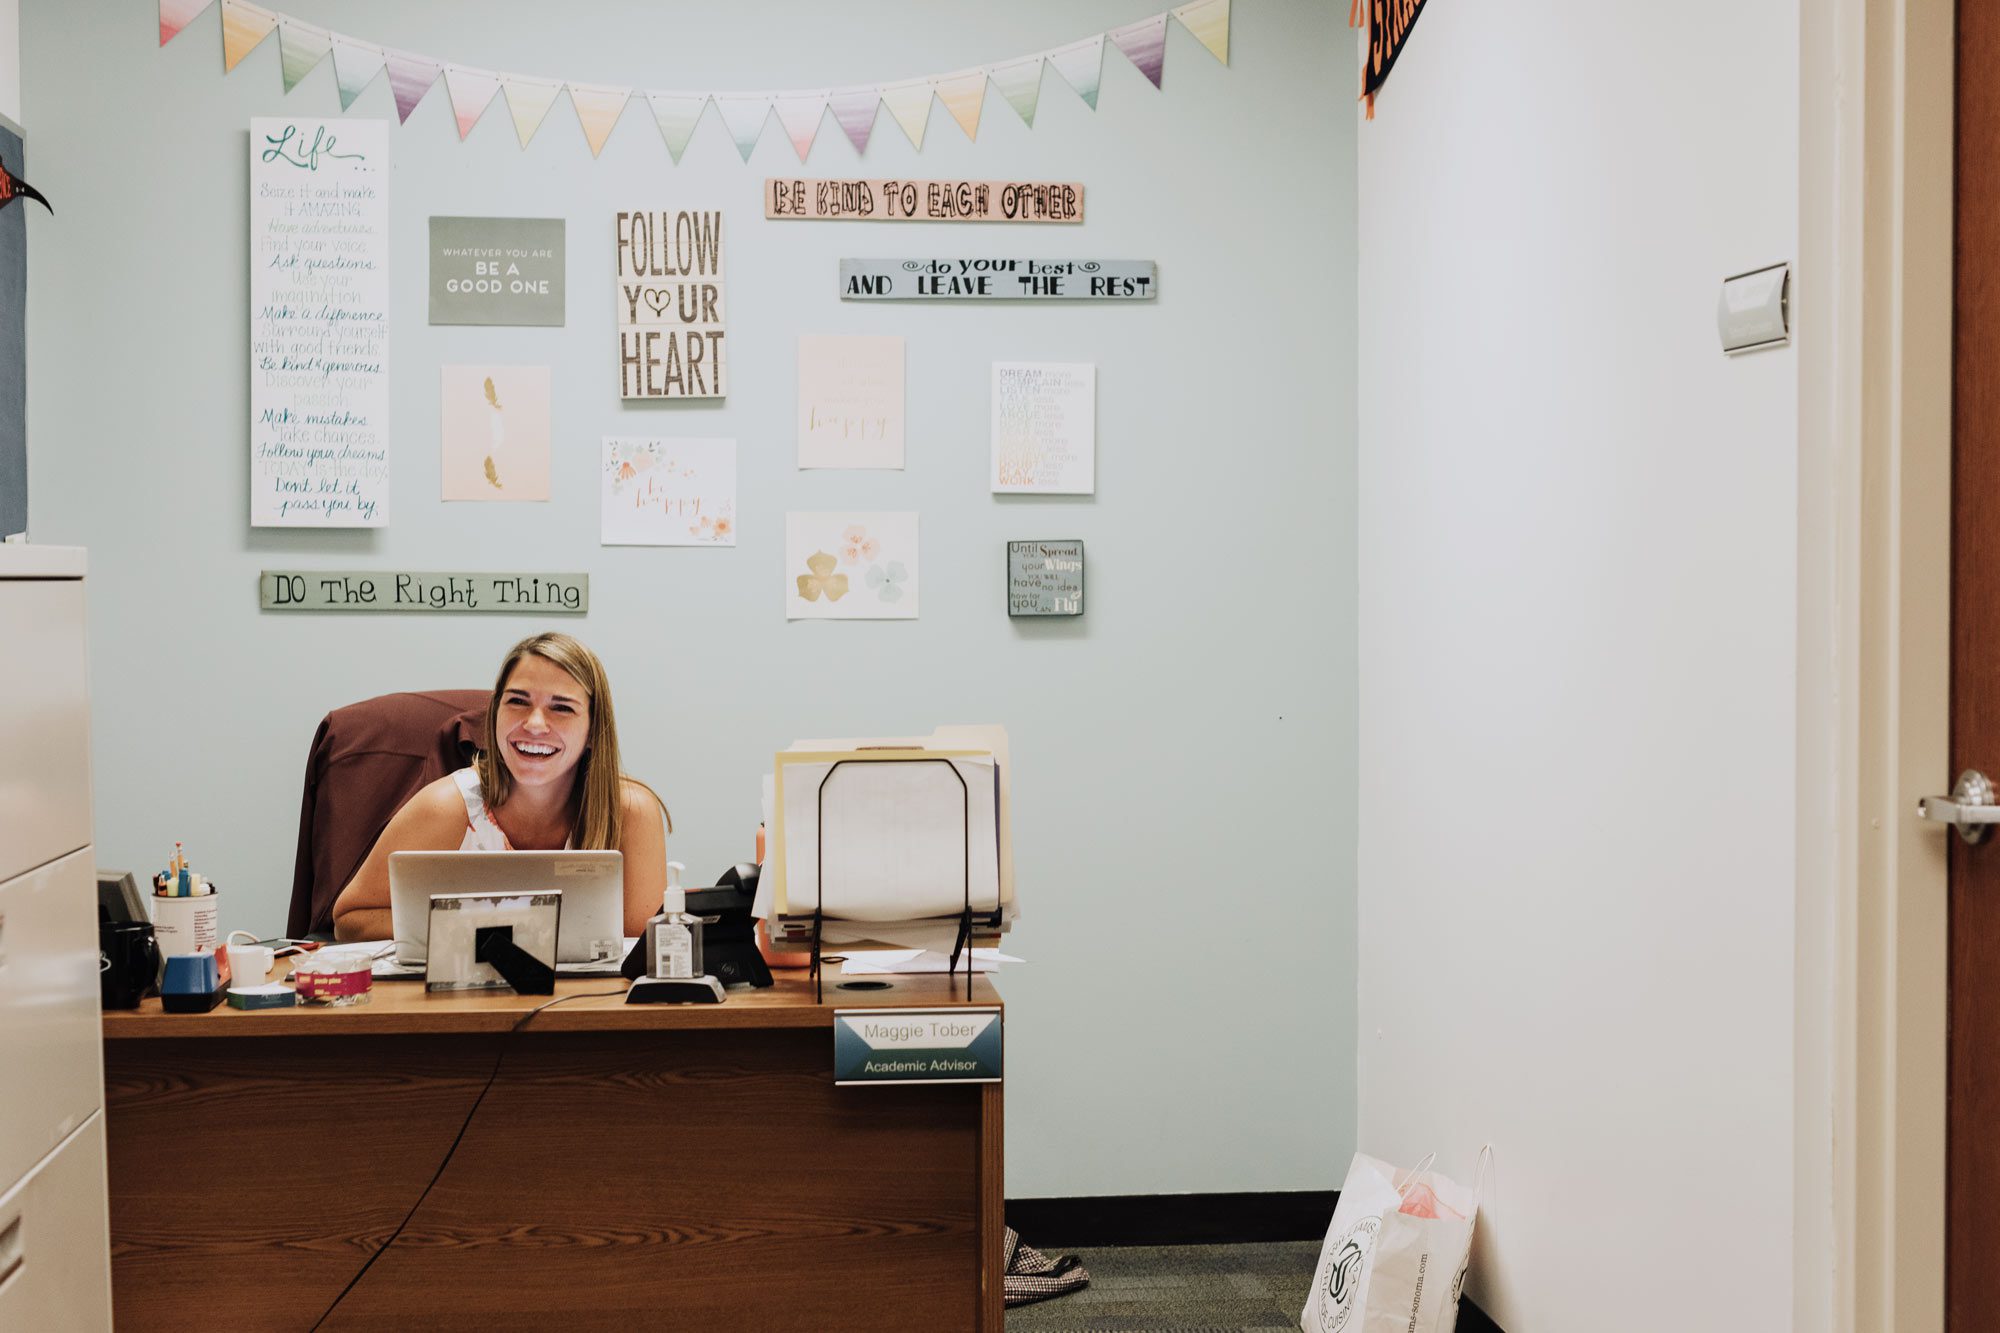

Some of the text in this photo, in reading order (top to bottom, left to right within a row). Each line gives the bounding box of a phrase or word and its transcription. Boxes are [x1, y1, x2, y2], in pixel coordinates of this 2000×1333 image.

[260, 182, 296, 199] Seize
[314, 179, 339, 199] and
[343, 184, 376, 199] make
[774, 180, 1076, 219] BE KIND TO EACH OTHER
[267, 217, 299, 233] Have
[261, 234, 289, 251] Find
[294, 240, 328, 257] your
[443, 248, 553, 258] WHATEVER YOU ARE
[617, 211, 721, 277] FOLLOW
[266, 253, 299, 271] Ask
[475, 261, 520, 276] BE A
[925, 259, 1075, 275] do your best
[446, 279, 550, 295] GOOD ONE
[847, 275, 1150, 297] AND LEAVE THE REST
[259, 304, 297, 326] Make
[301, 308, 311, 320] a
[253, 339, 285, 354] with
[289, 341, 324, 363] good
[258, 356, 278, 370] Be
[281, 356, 314, 371] kind
[621, 331, 725, 397] HEART
[1000, 369, 1042, 378] DREAM
[258, 407, 300, 431] Make
[276, 424, 310, 442] Take
[257, 441, 304, 462] Follow
[306, 447, 335, 477] your
[314, 477, 342, 494] let
[345, 479, 361, 495] it
[273, 499, 319, 518] pass
[322, 499, 351, 519] you
[1011, 542, 1078, 558] Until Spread
[1021, 562, 1044, 574] your
[320, 577, 377, 604] The
[394, 573, 478, 609] Right
[493, 577, 581, 609] Thing
[1013, 578, 1042, 588] have
[1041, 579, 1079, 592] no idea
[1013, 599, 1038, 613] you
[1054, 597, 1079, 615] Fly
[865, 1022, 977, 1042] Maggie Tober
[864, 1058, 978, 1073] Academic Advisor
